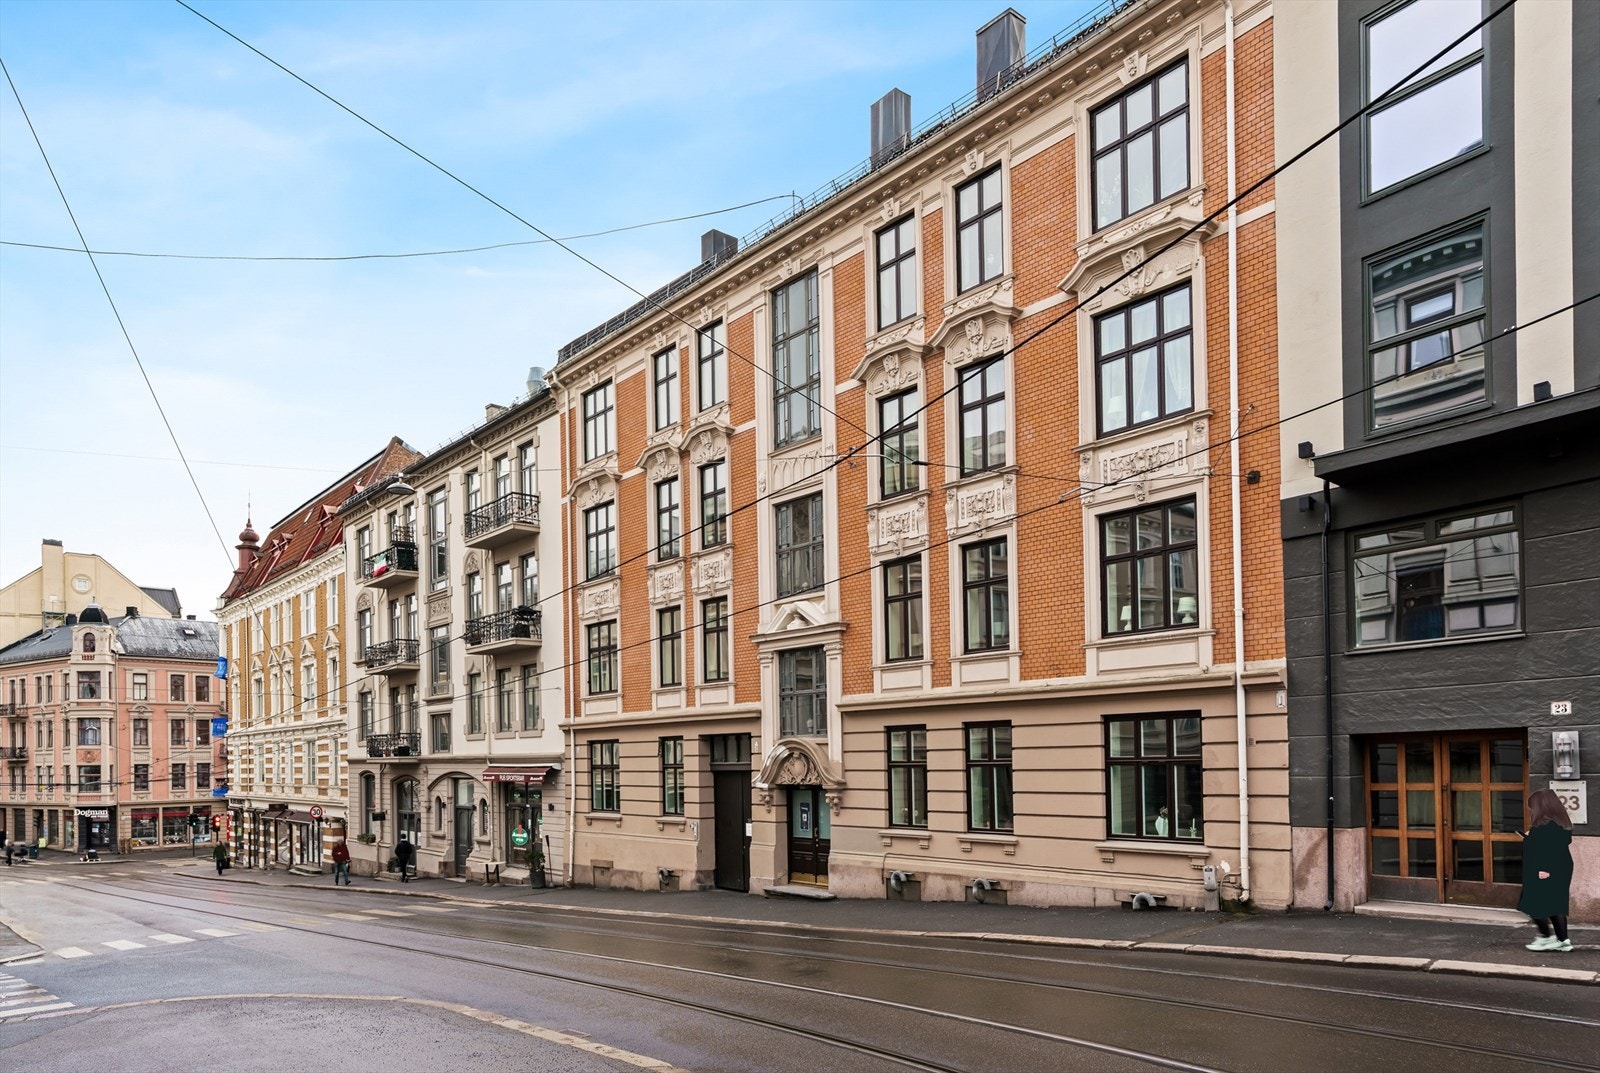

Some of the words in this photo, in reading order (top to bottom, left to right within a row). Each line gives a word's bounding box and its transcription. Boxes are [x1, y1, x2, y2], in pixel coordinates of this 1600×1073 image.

[1554, 703, 1568, 713] 23
[1558, 795, 1580, 810] 23
[74, 808, 108, 817] Dogman
[312, 808, 321, 816] 30
